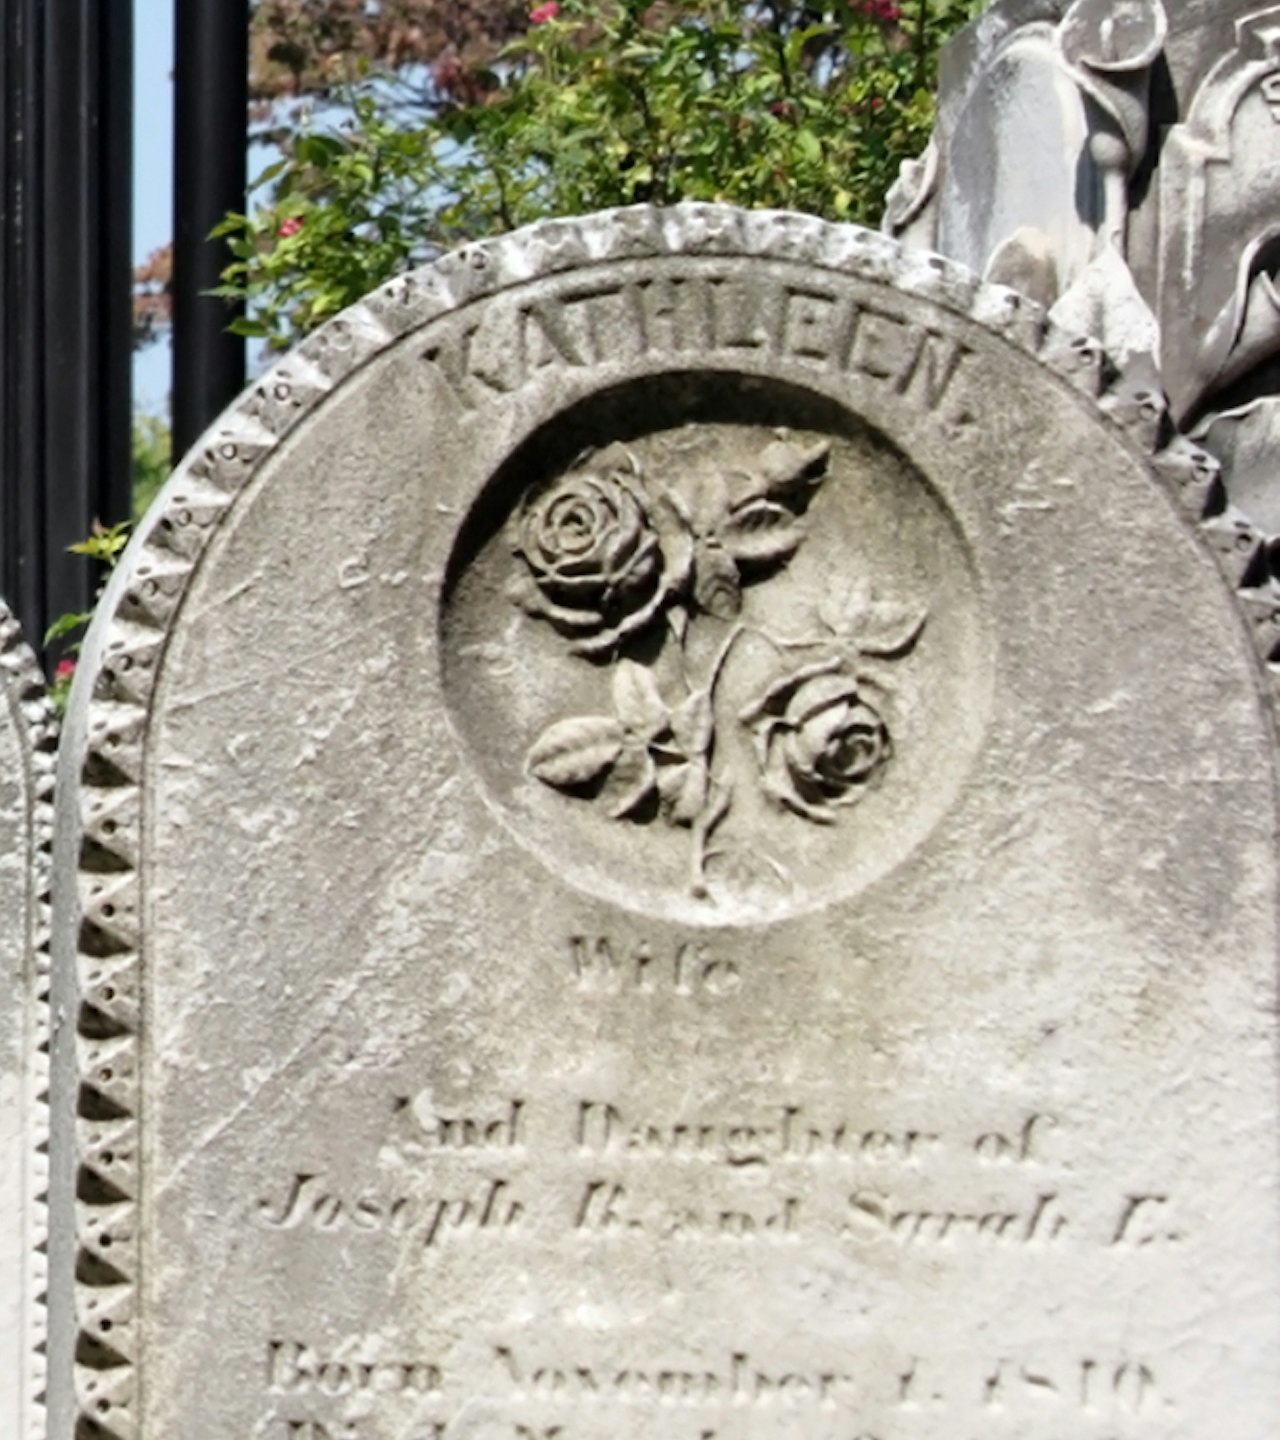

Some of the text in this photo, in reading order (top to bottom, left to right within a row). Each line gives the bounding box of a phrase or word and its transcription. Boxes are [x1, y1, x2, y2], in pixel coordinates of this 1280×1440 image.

[569, 935, 738, 993] Wife
[579, 1100, 942, 1167] Daughter
[975, 1111, 1059, 1162] of
[257, 1173, 525, 1246] Joseph
[848, 1190, 1069, 1243] Sarah
[265, 1340, 443, 1394] Born
[494, 1345, 852, 1406] November
